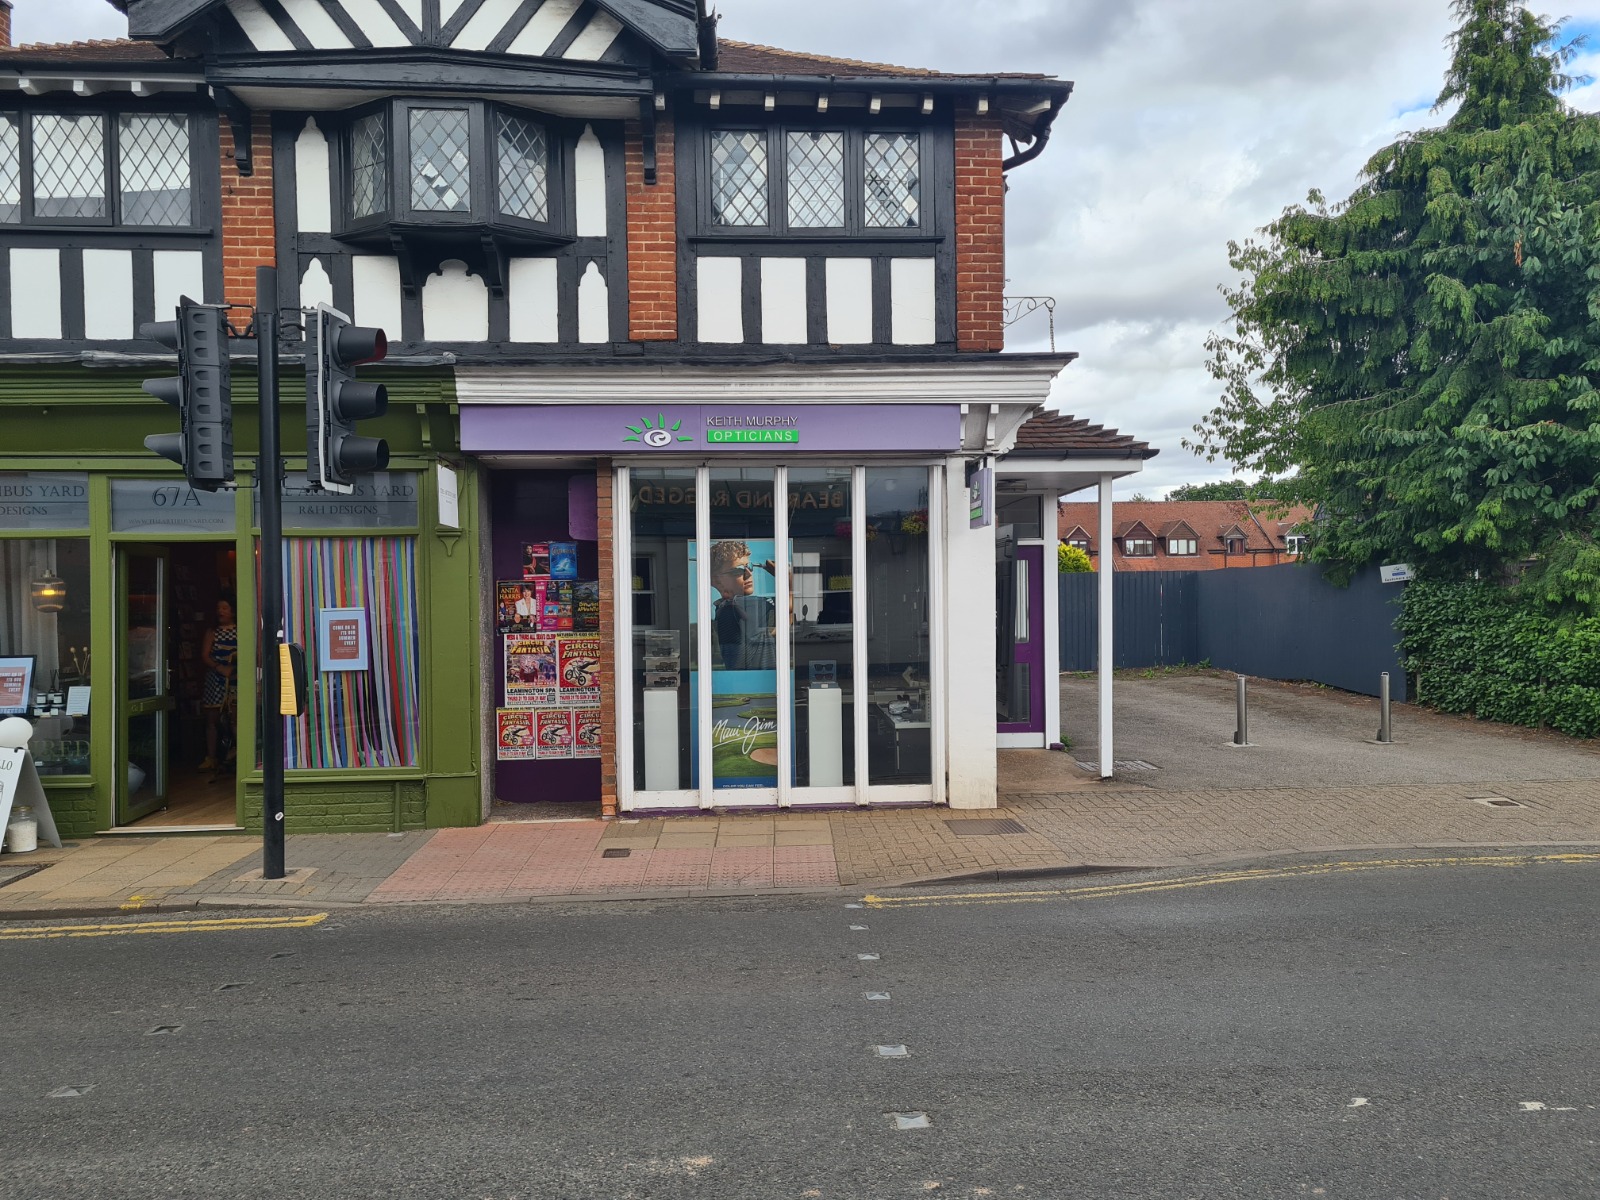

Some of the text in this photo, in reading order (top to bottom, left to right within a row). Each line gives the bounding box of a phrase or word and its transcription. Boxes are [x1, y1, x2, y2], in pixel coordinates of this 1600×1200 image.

[706, 415, 798, 427] KEITH MURPHY
[713, 430, 793, 442] OPTICIANS
[39, 485, 85, 497] YARD
[151, 486, 202, 507] 67A
[371, 485, 414, 497] YARD
[299, 505, 378, 515] R&H DESIGNS
[564, 642, 599, 650] CIRCUS
[712, 716, 777, 755] Maui Jim
